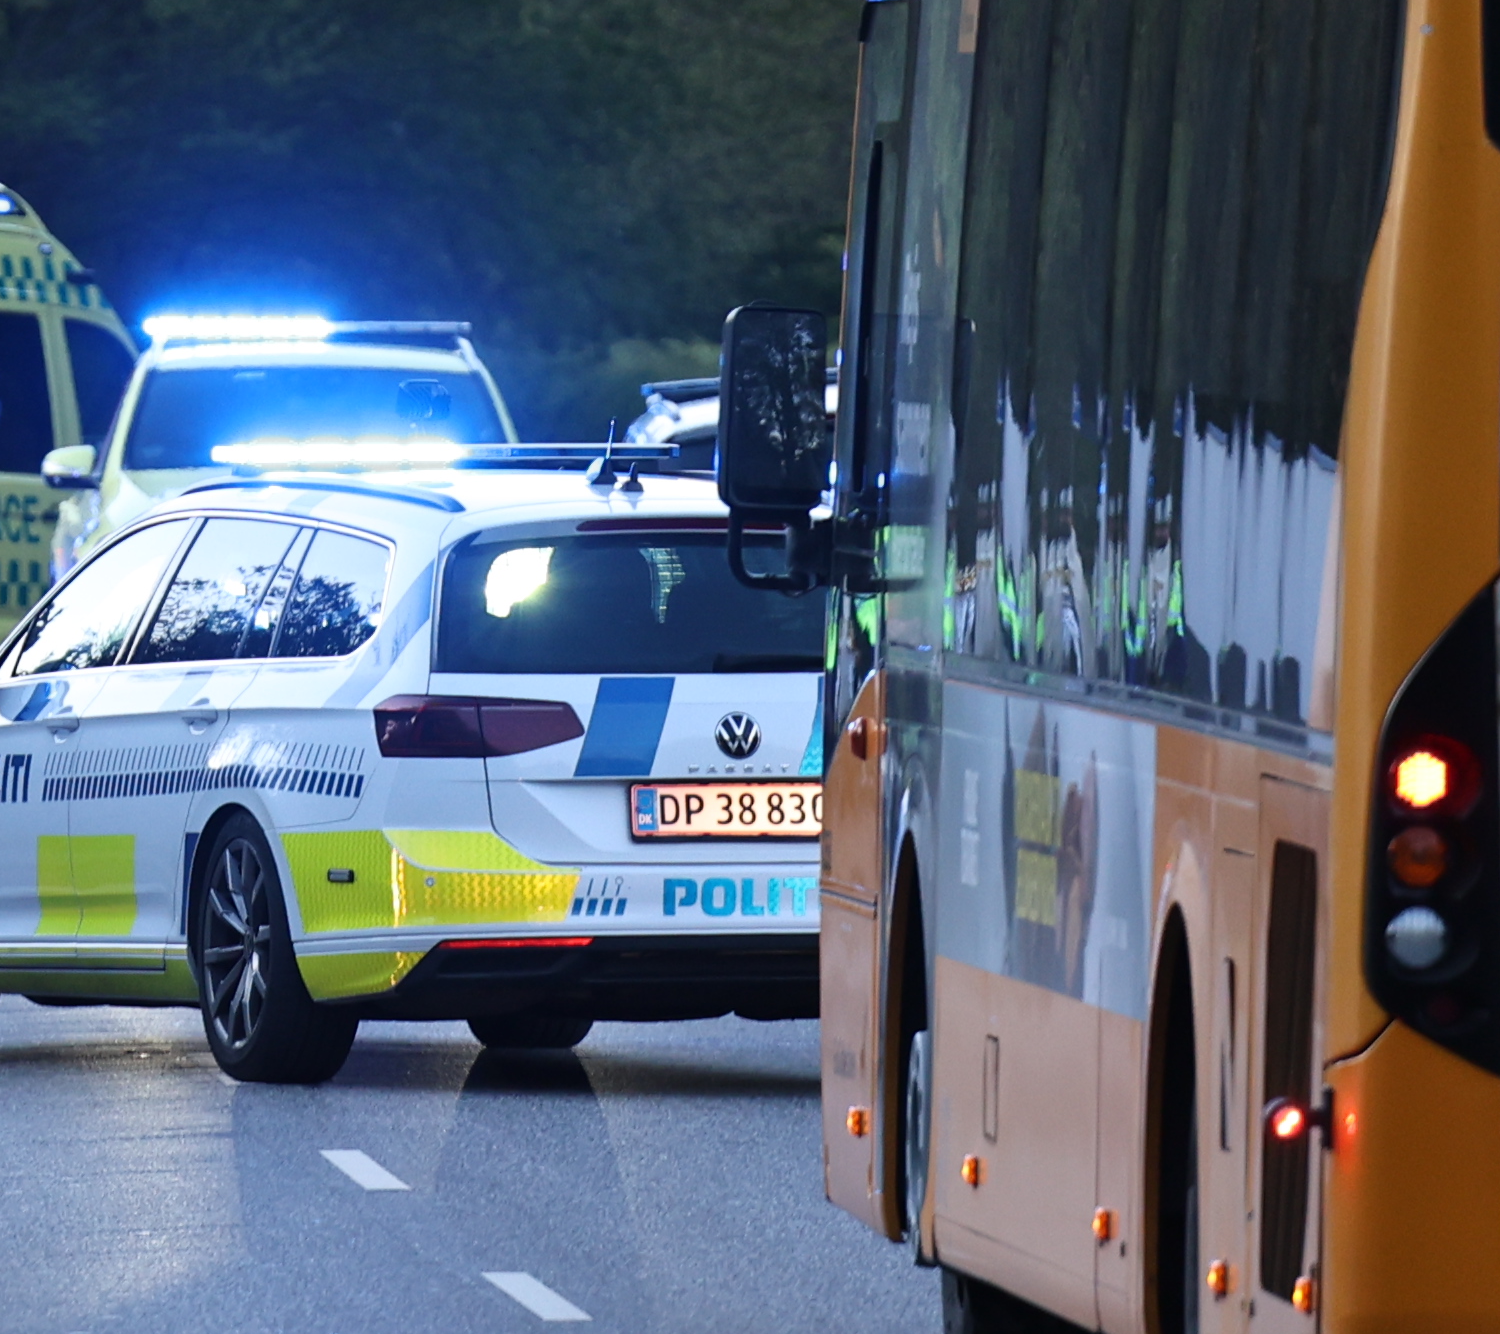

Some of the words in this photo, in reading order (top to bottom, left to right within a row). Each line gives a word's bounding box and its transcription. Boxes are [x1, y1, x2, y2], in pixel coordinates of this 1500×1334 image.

[638, 813, 653, 825] DK
[659, 793, 704, 825] DP
[716, 793, 757, 825] 38
[663, 878, 819, 917] POLIT
